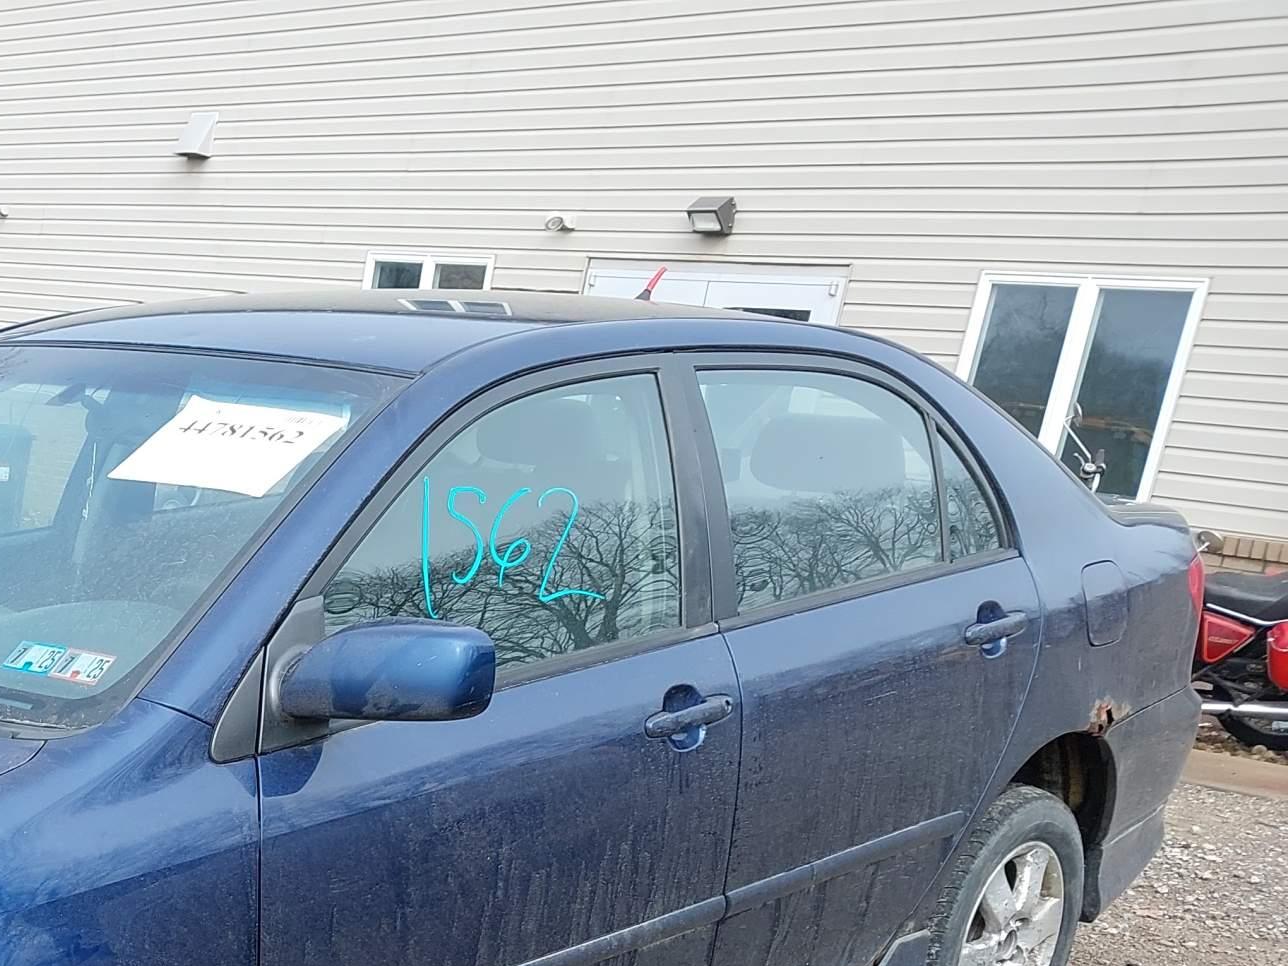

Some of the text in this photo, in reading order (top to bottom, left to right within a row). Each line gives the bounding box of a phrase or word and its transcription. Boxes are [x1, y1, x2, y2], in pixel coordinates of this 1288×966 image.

[178, 419, 305, 444] 44781562
[421, 476, 607, 620] 1562
[37, 649, 63, 670] 25
[86, 658, 111, 679] 25
